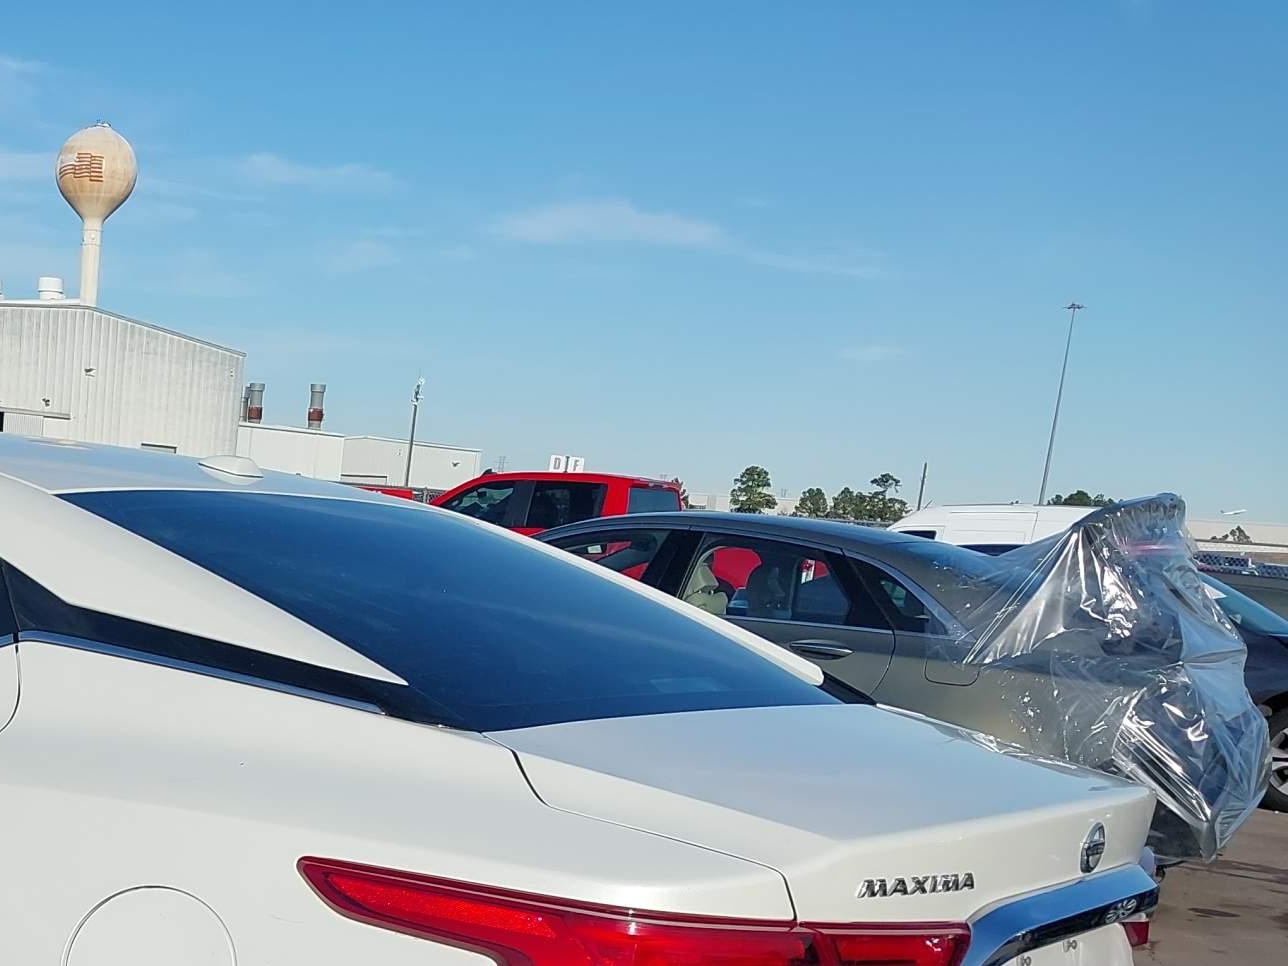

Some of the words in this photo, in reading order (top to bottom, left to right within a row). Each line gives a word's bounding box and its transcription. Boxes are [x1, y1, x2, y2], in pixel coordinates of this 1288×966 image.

[553, 457, 562, 470] D
[573, 459, 580, 472] F
[857, 872, 975, 898] MAXIMA
